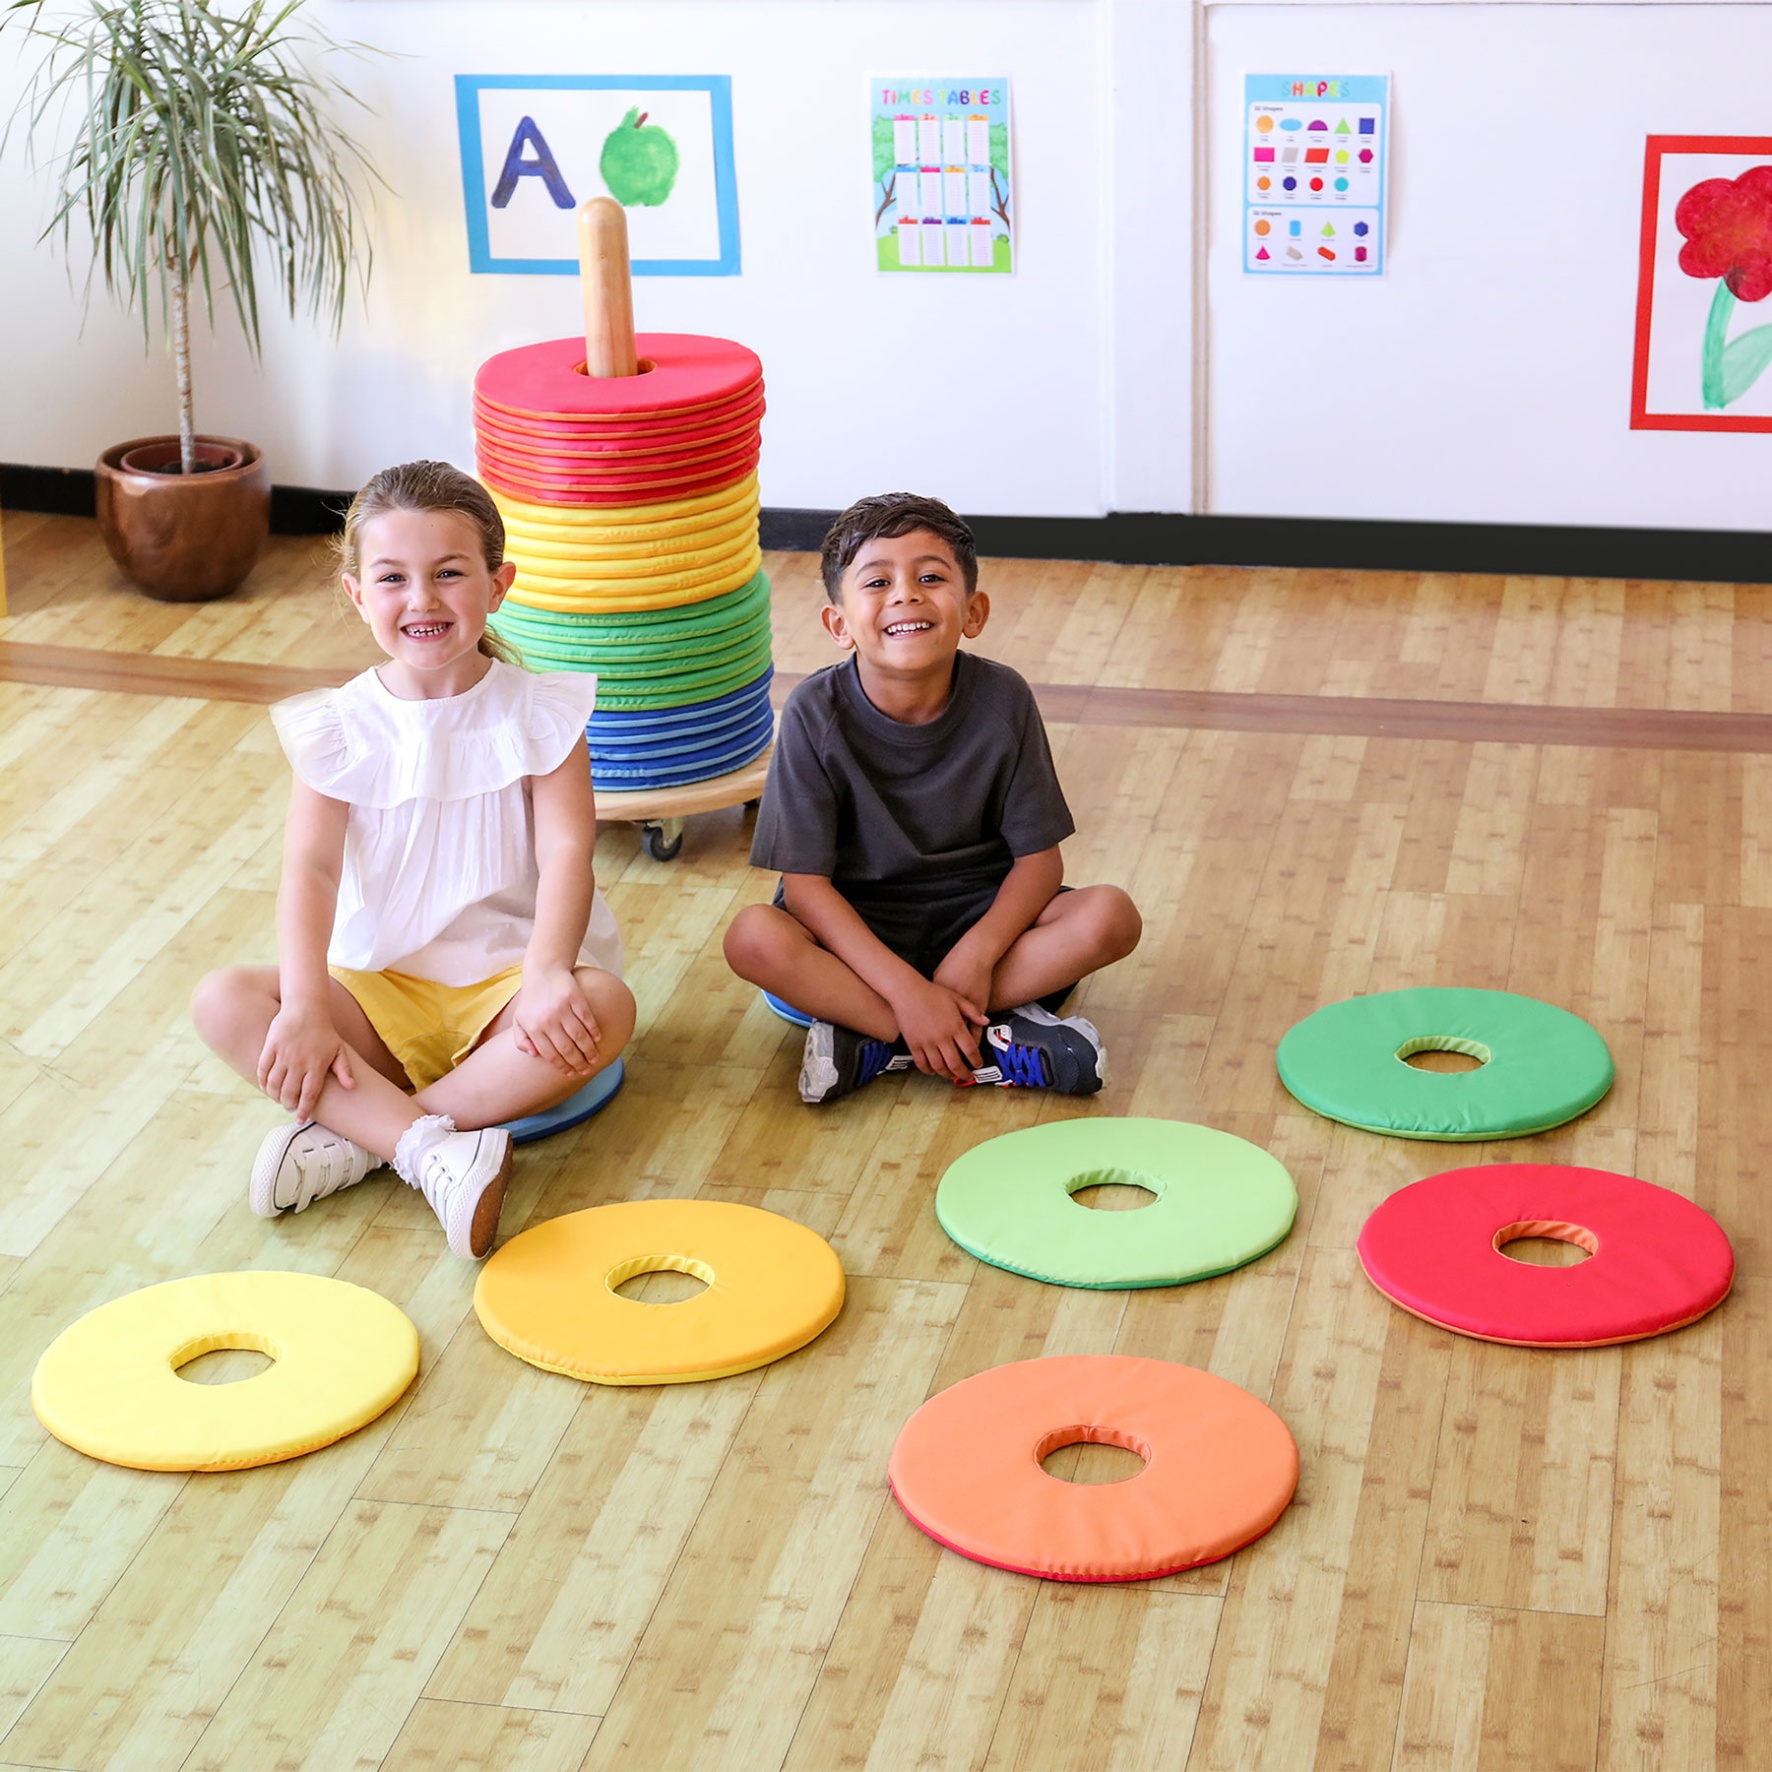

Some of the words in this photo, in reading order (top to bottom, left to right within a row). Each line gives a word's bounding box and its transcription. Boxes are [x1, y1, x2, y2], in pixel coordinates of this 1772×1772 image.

[1281, 81, 1350, 97] SHAPES
[882, 90, 933, 105] TIMES
[939, 90, 1001, 105] TABLES
[491, 115, 576, 209] A
